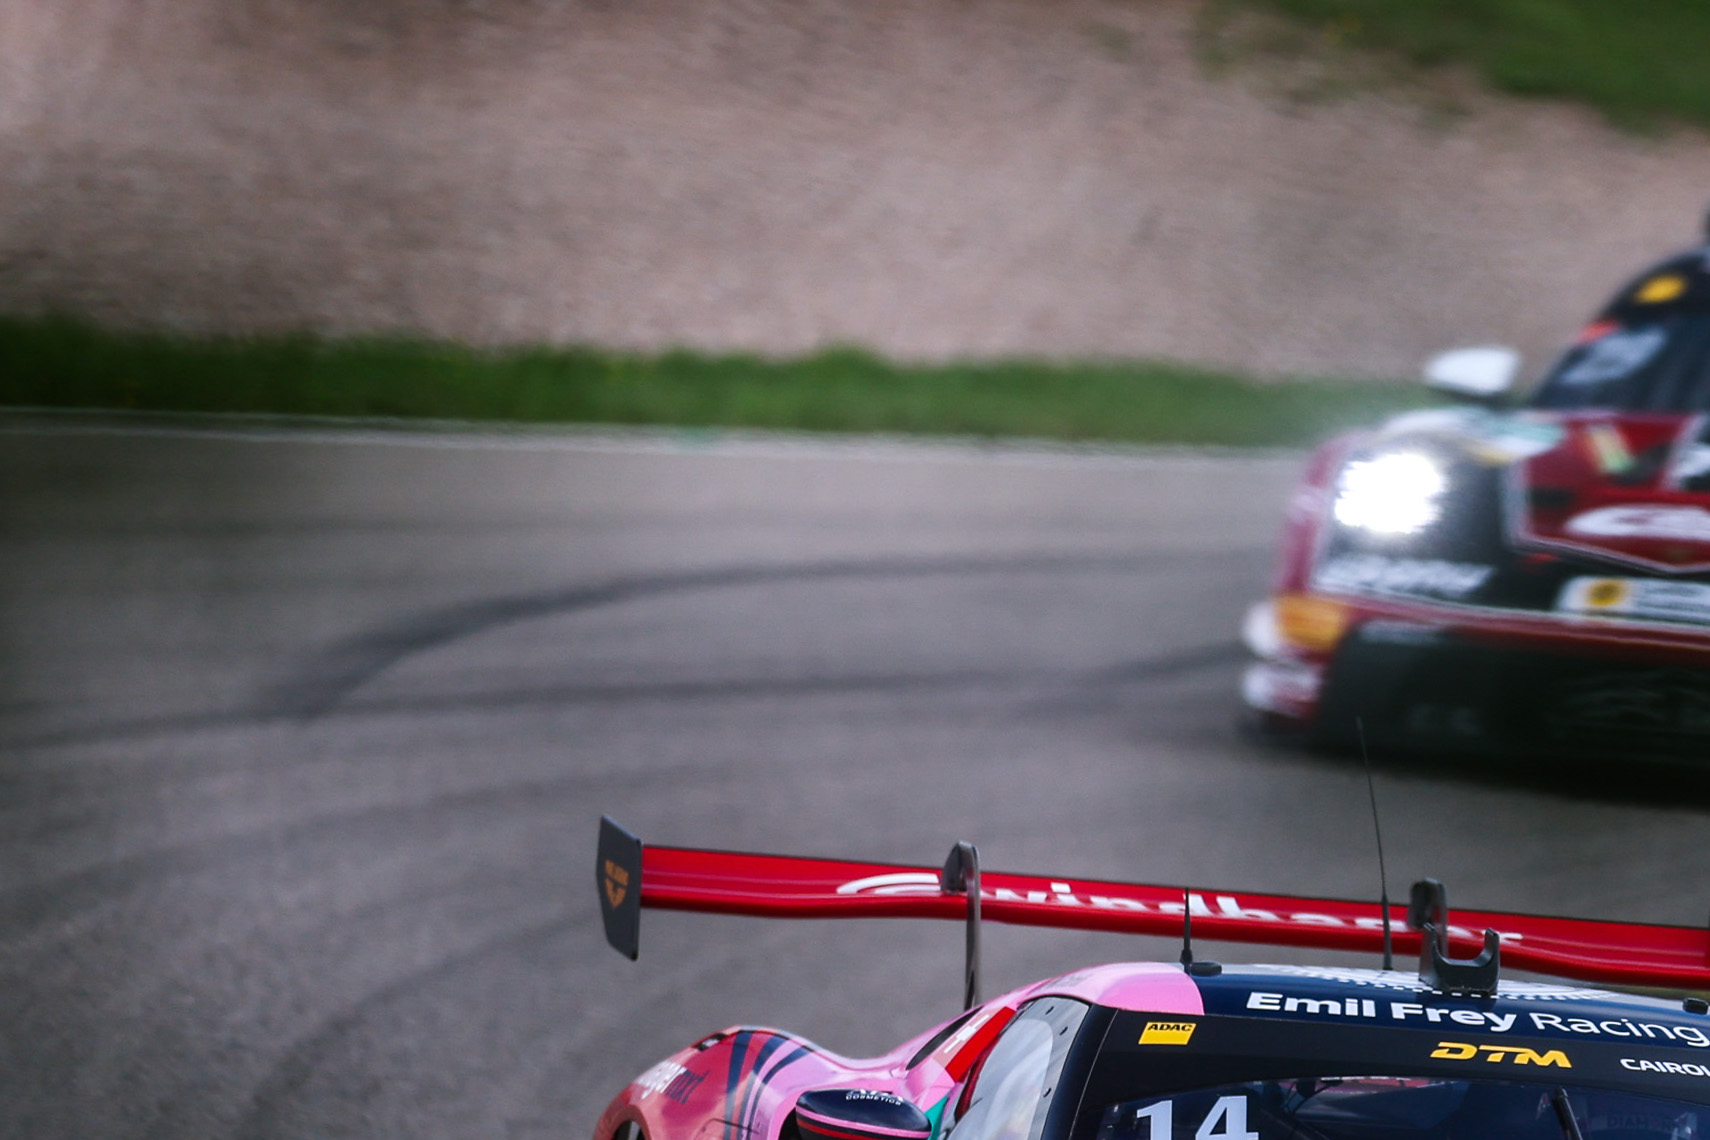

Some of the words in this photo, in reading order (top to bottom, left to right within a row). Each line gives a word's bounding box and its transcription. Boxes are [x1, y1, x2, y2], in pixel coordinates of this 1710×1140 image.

[1147, 1023, 1193, 1032] ADAC
[1246, 992, 1376, 1018] Emil
[1391, 1002, 1517, 1032] Frey
[1529, 1012, 1710, 1047] Racing
[1430, 1041, 1573, 1068] DTM
